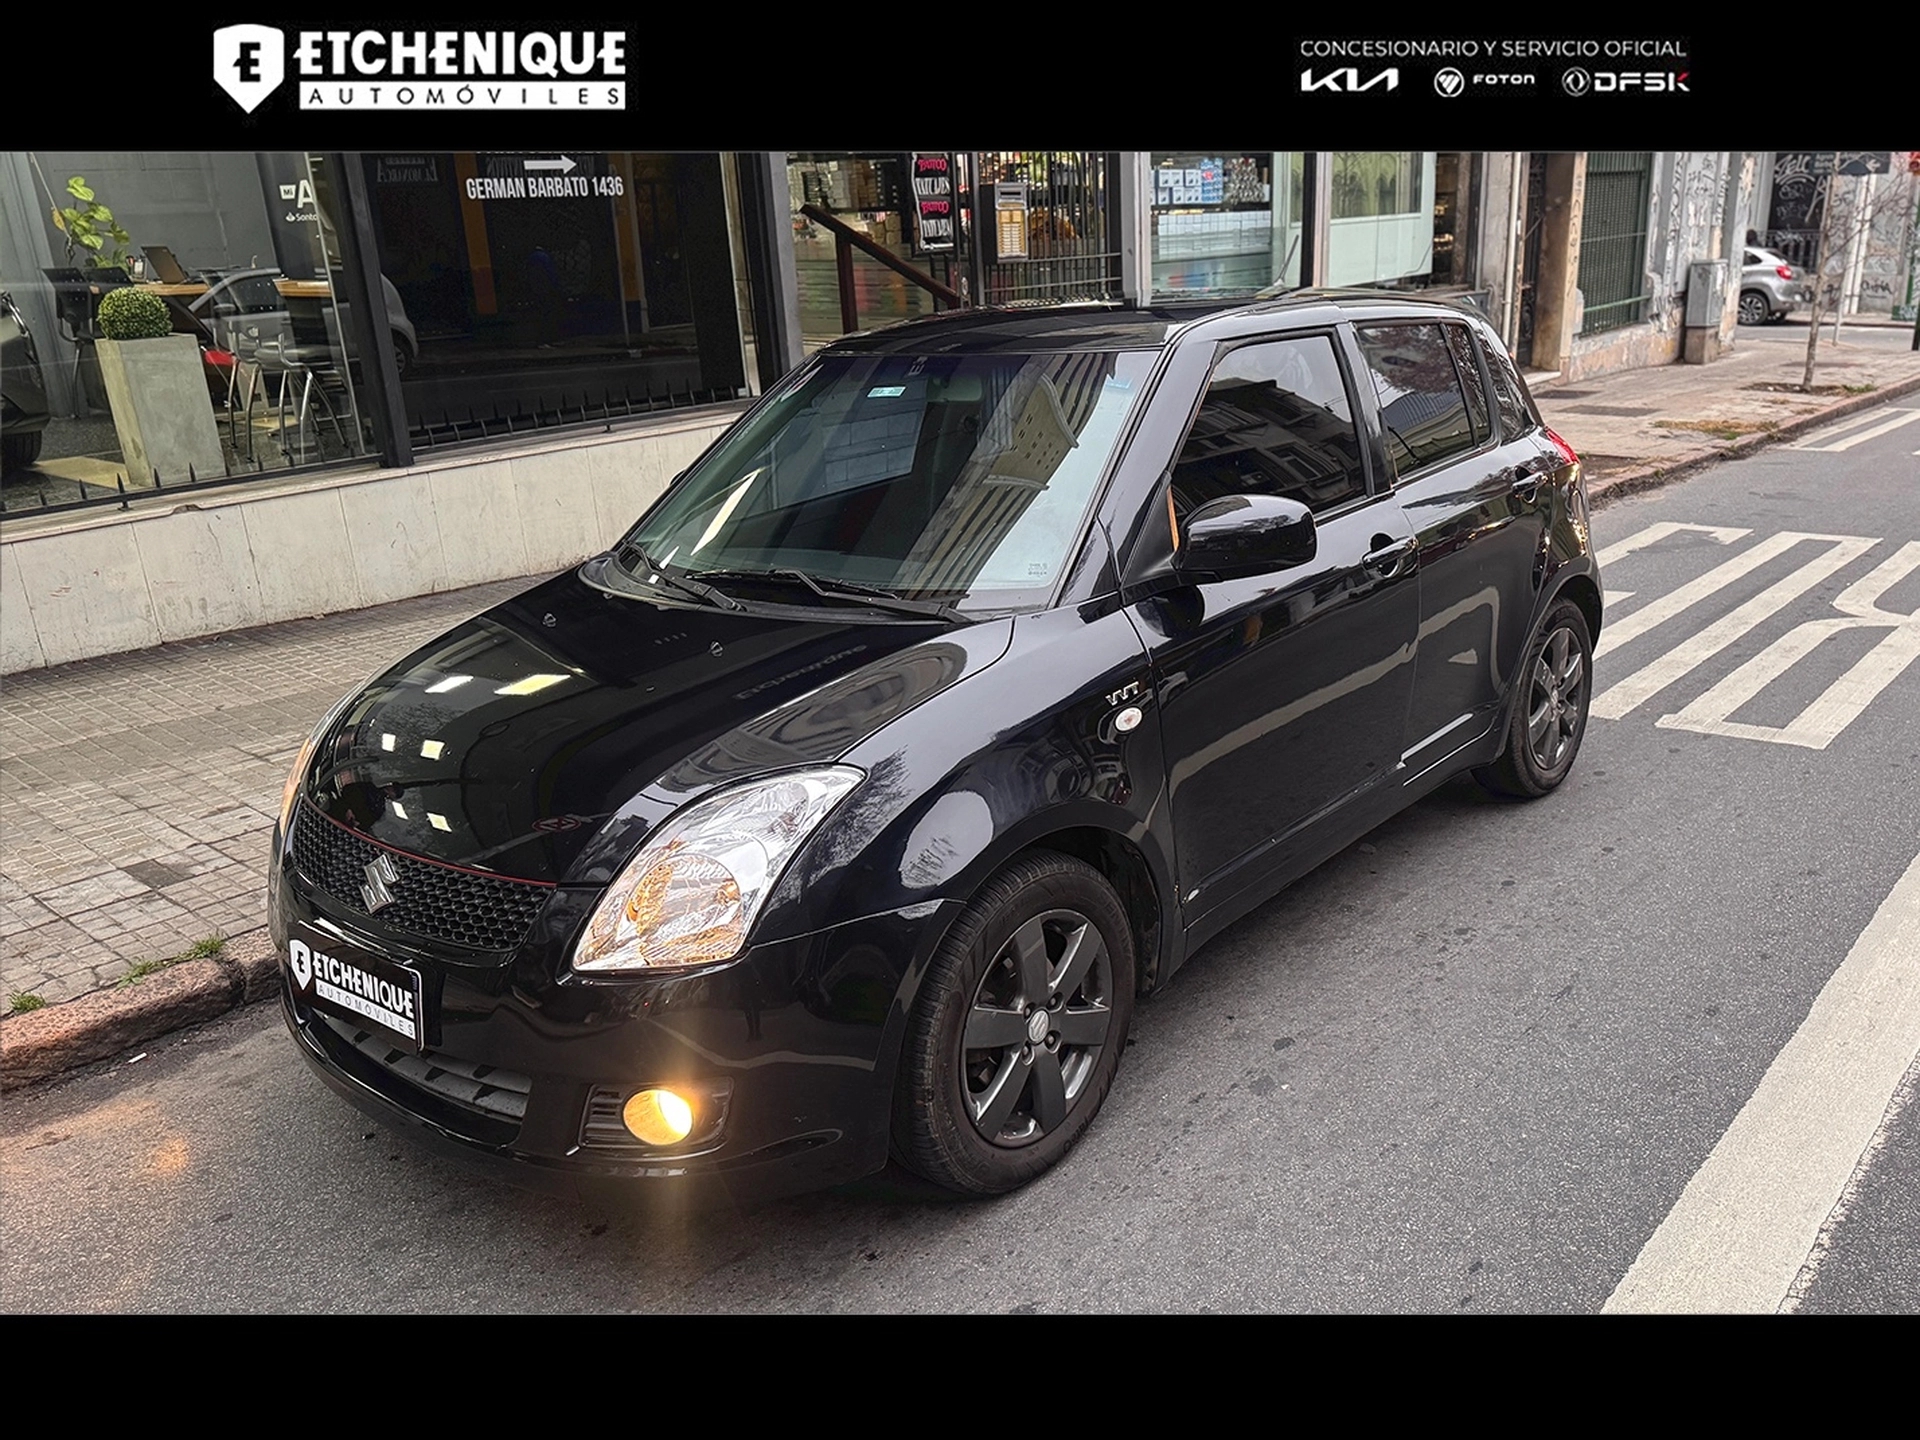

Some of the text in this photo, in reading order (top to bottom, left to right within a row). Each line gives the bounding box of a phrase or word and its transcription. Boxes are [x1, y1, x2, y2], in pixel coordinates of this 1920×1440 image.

[466, 176, 624, 200] GERMAN BARBATO 1436
[1105, 681, 1139, 706] VVT
[312, 950, 415, 1019] ETCHENIQUE
